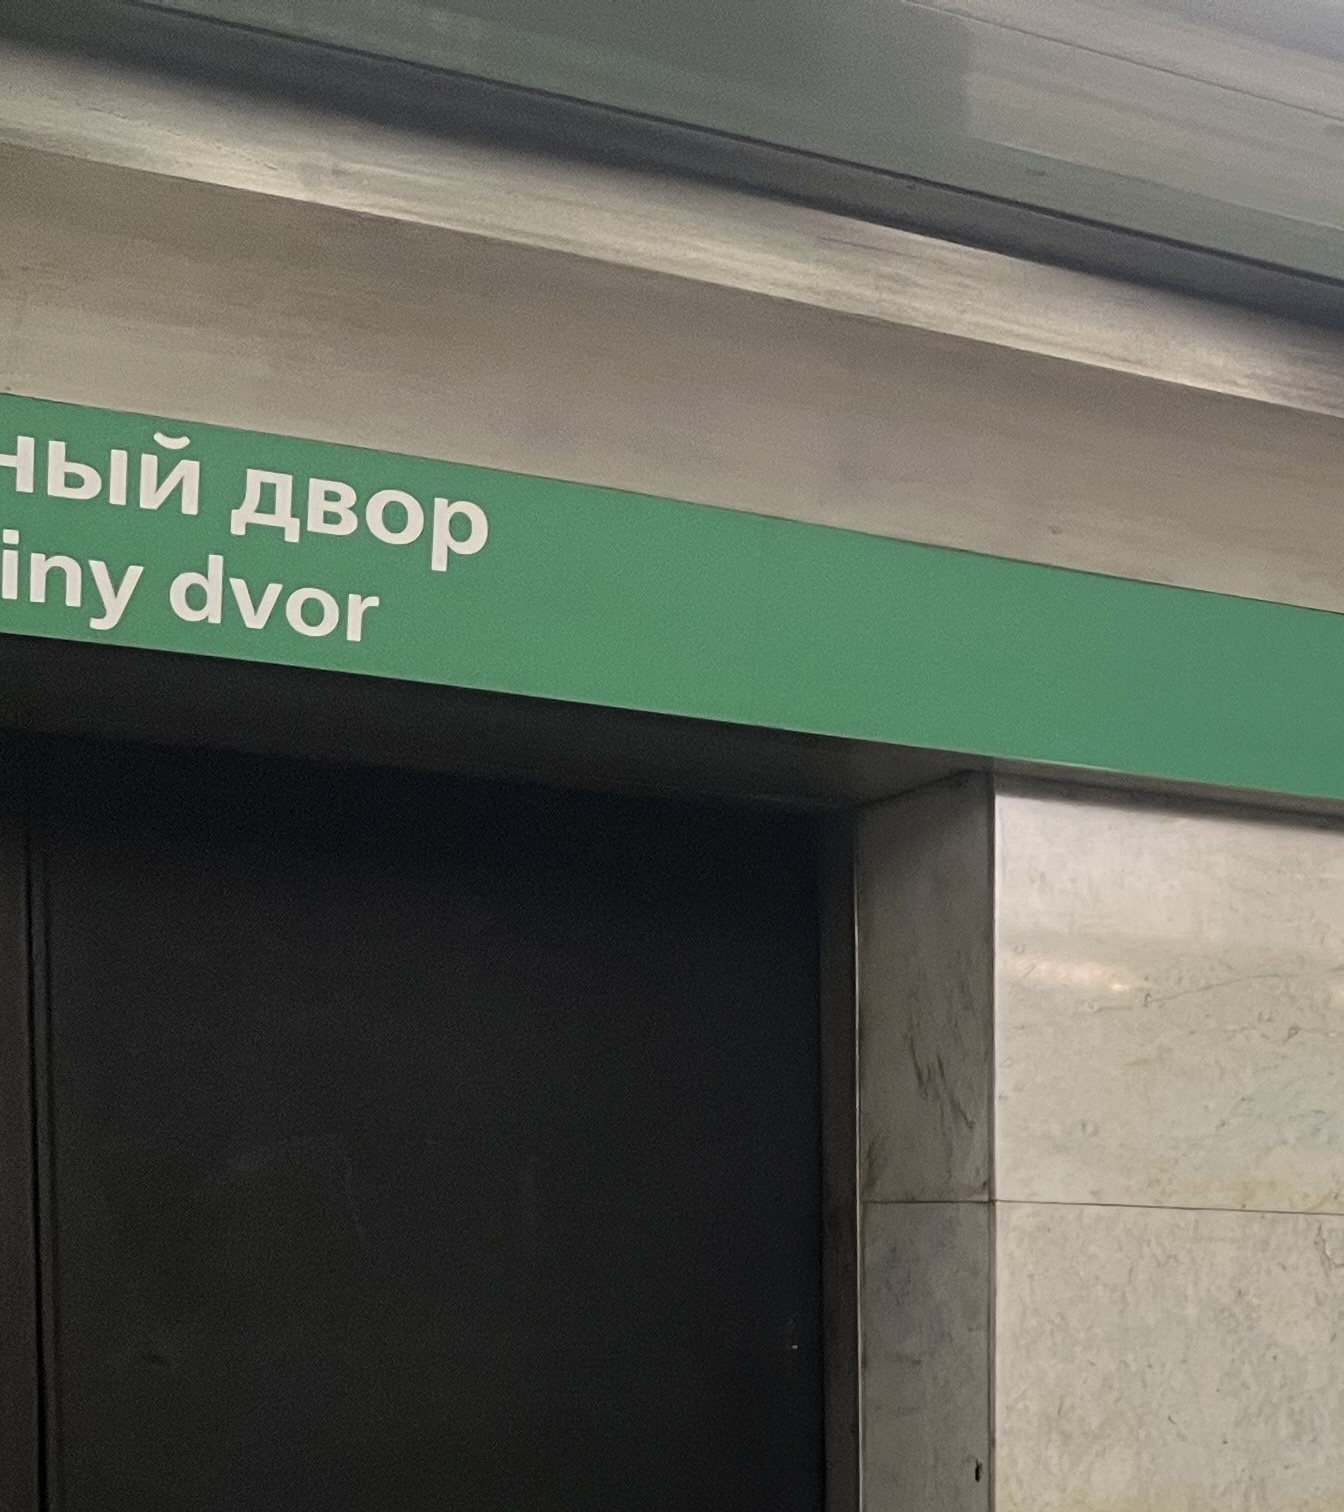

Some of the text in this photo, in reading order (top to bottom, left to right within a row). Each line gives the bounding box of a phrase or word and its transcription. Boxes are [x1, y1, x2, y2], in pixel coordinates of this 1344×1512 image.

[230, 468, 489, 571] двор
[1, 529, 380, 642] iny dvor
